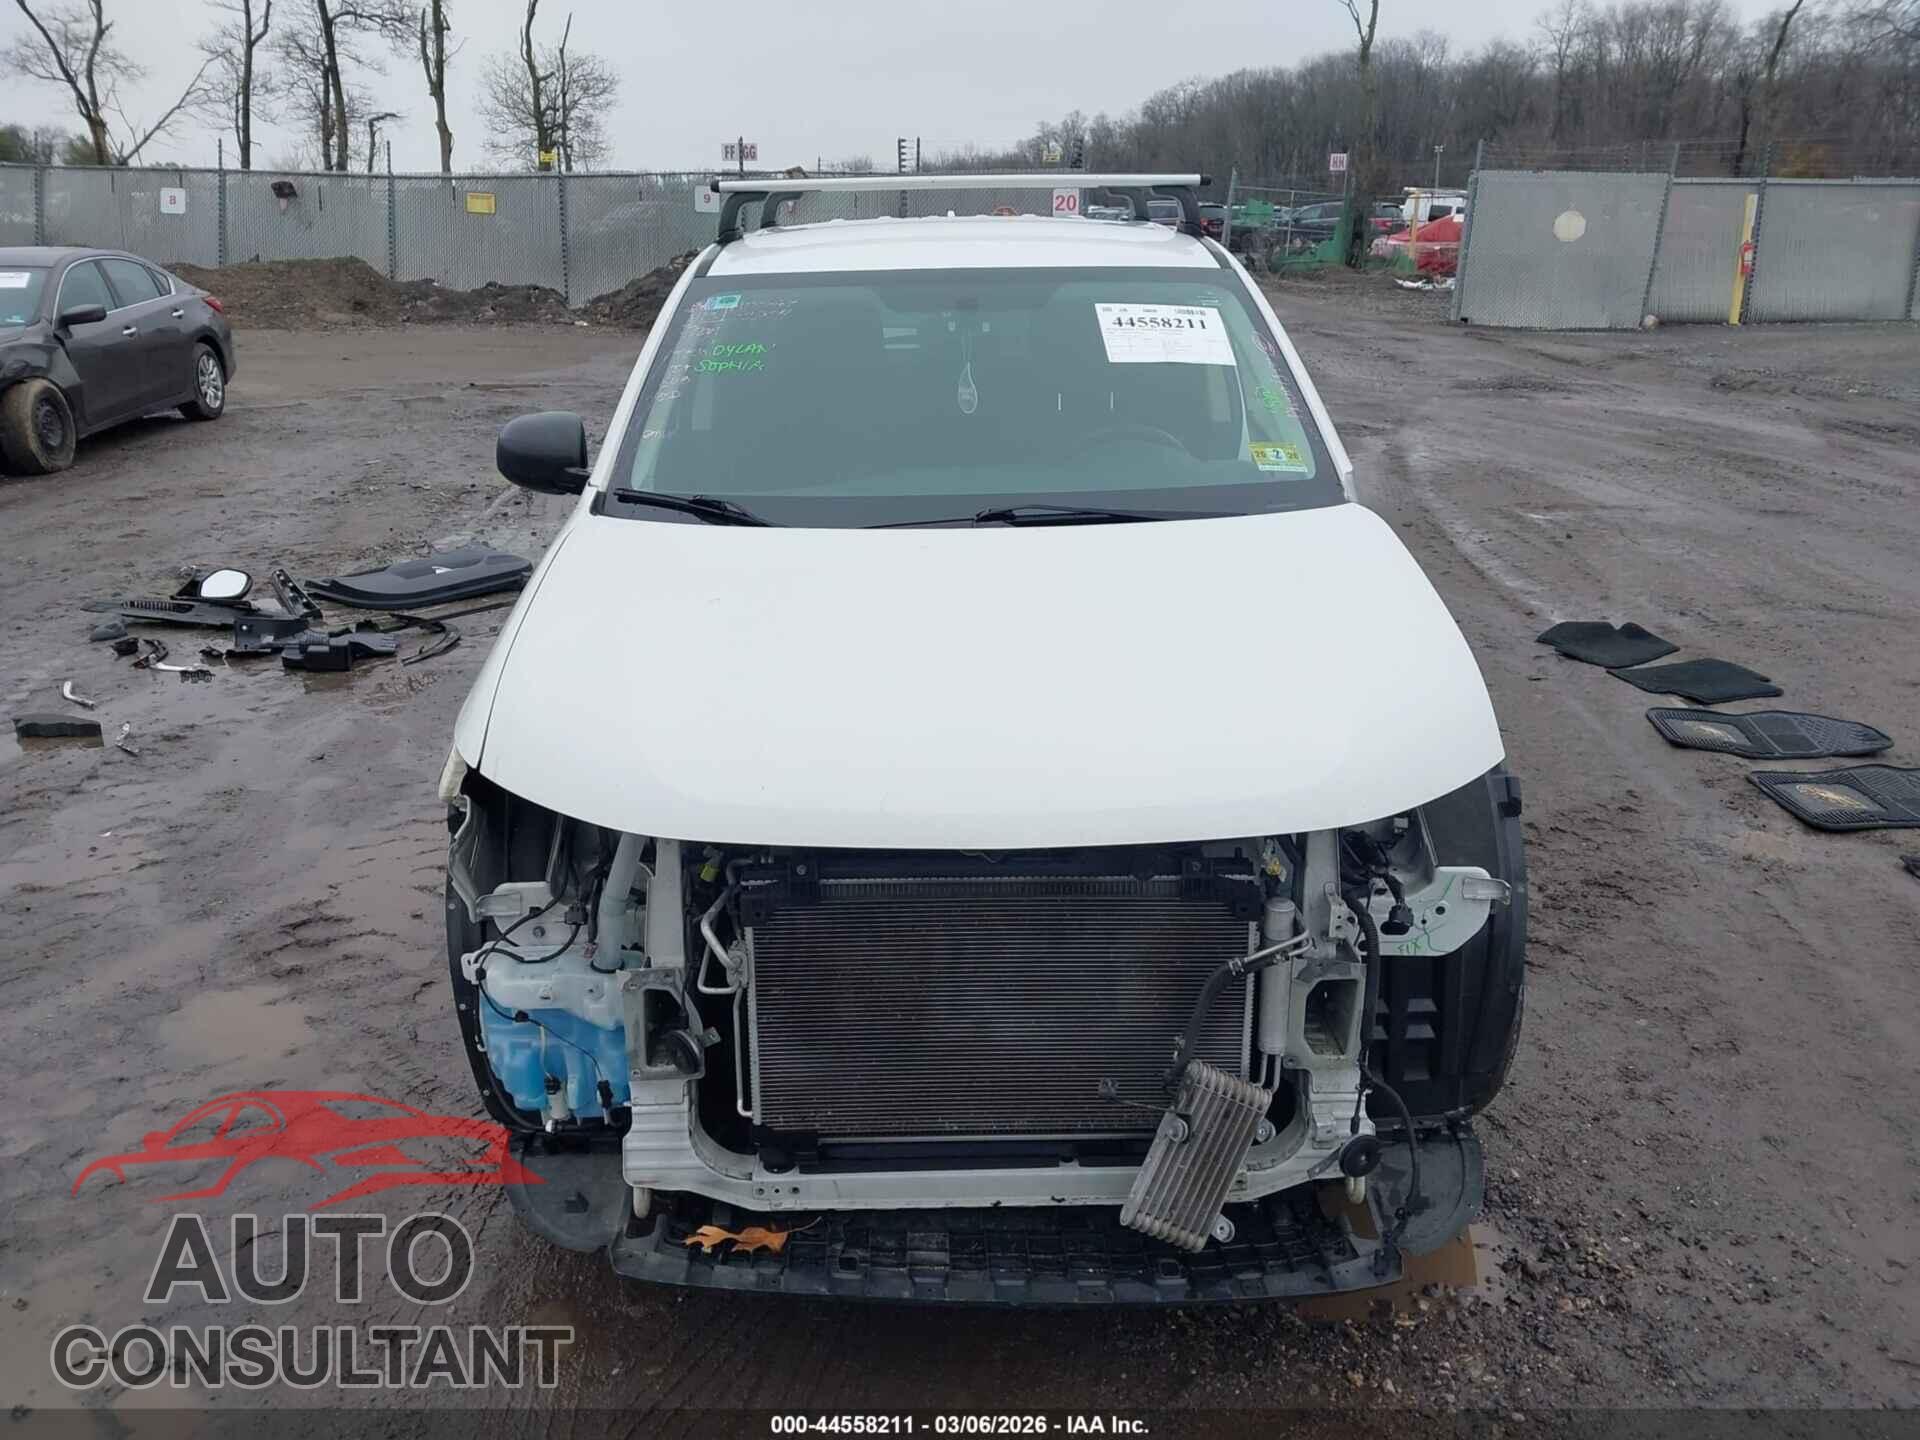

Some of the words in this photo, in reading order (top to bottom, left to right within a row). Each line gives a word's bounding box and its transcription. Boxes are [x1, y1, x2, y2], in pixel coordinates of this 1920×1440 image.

[724, 144, 736, 159] FF
[743, 144, 756, 159] GG
[1055, 194, 1077, 212] 20
[1112, 316, 1207, 330] 44558211
